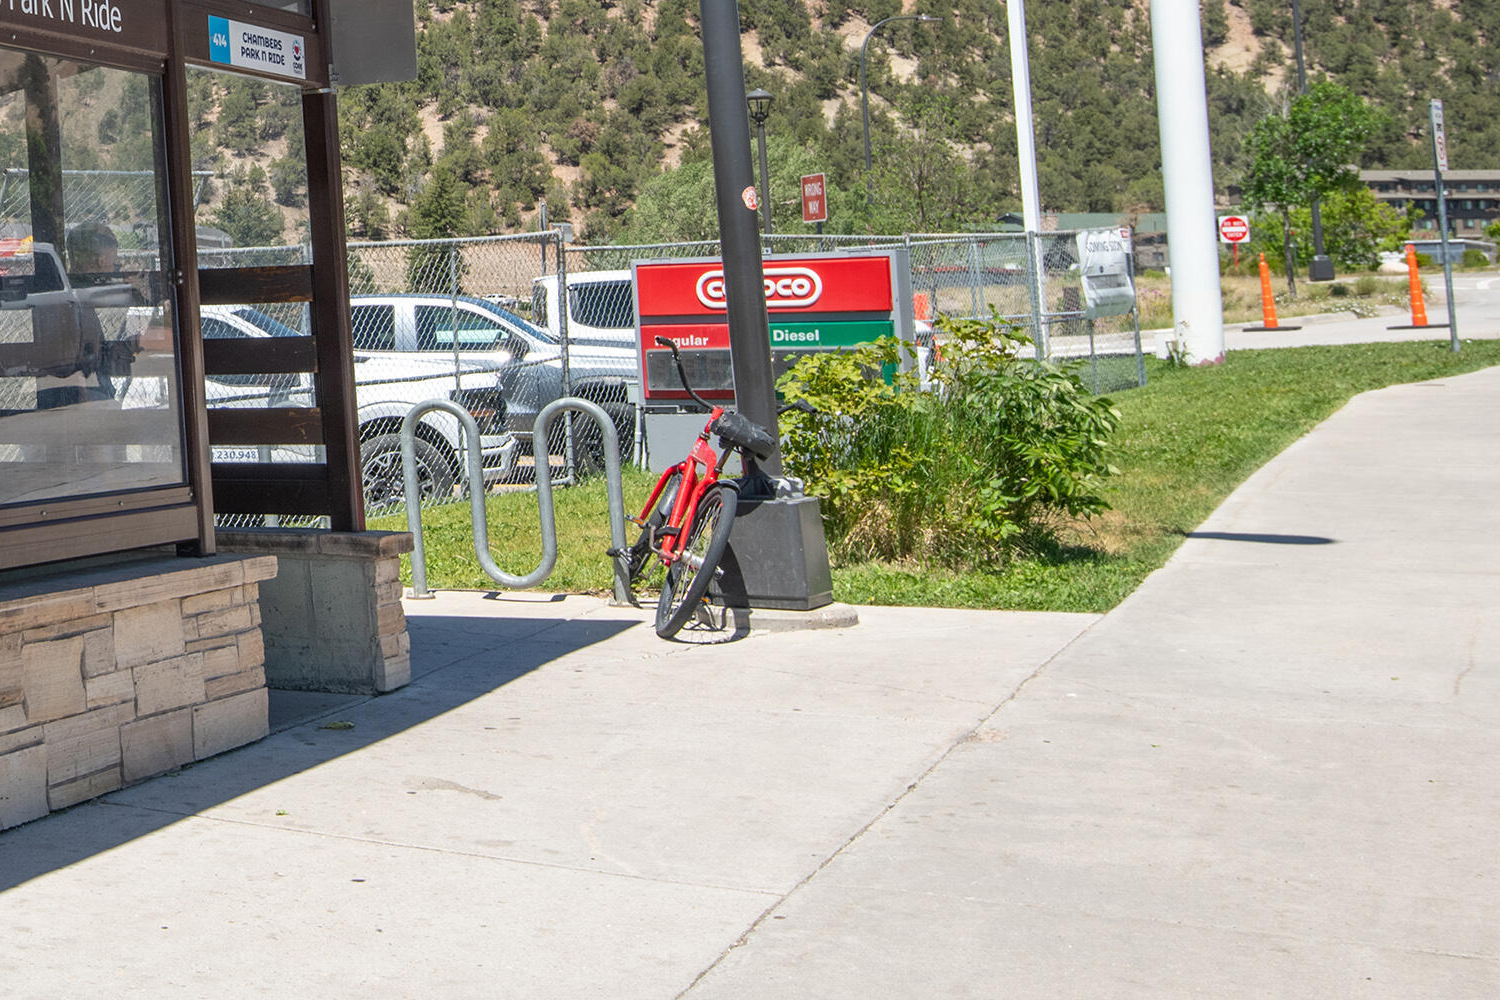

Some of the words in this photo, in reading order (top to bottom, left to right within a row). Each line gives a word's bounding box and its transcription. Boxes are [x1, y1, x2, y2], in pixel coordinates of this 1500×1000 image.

[213, 33, 227, 48] 414
[242, 32, 283, 51] CHAMBERS
[241, 46, 260, 60] PARK
[268, 53, 285, 65] RIDE
[707, 278, 811, 298] coco
[654, 334, 709, 350] Rgular
[773, 329, 819, 341] Diesel
